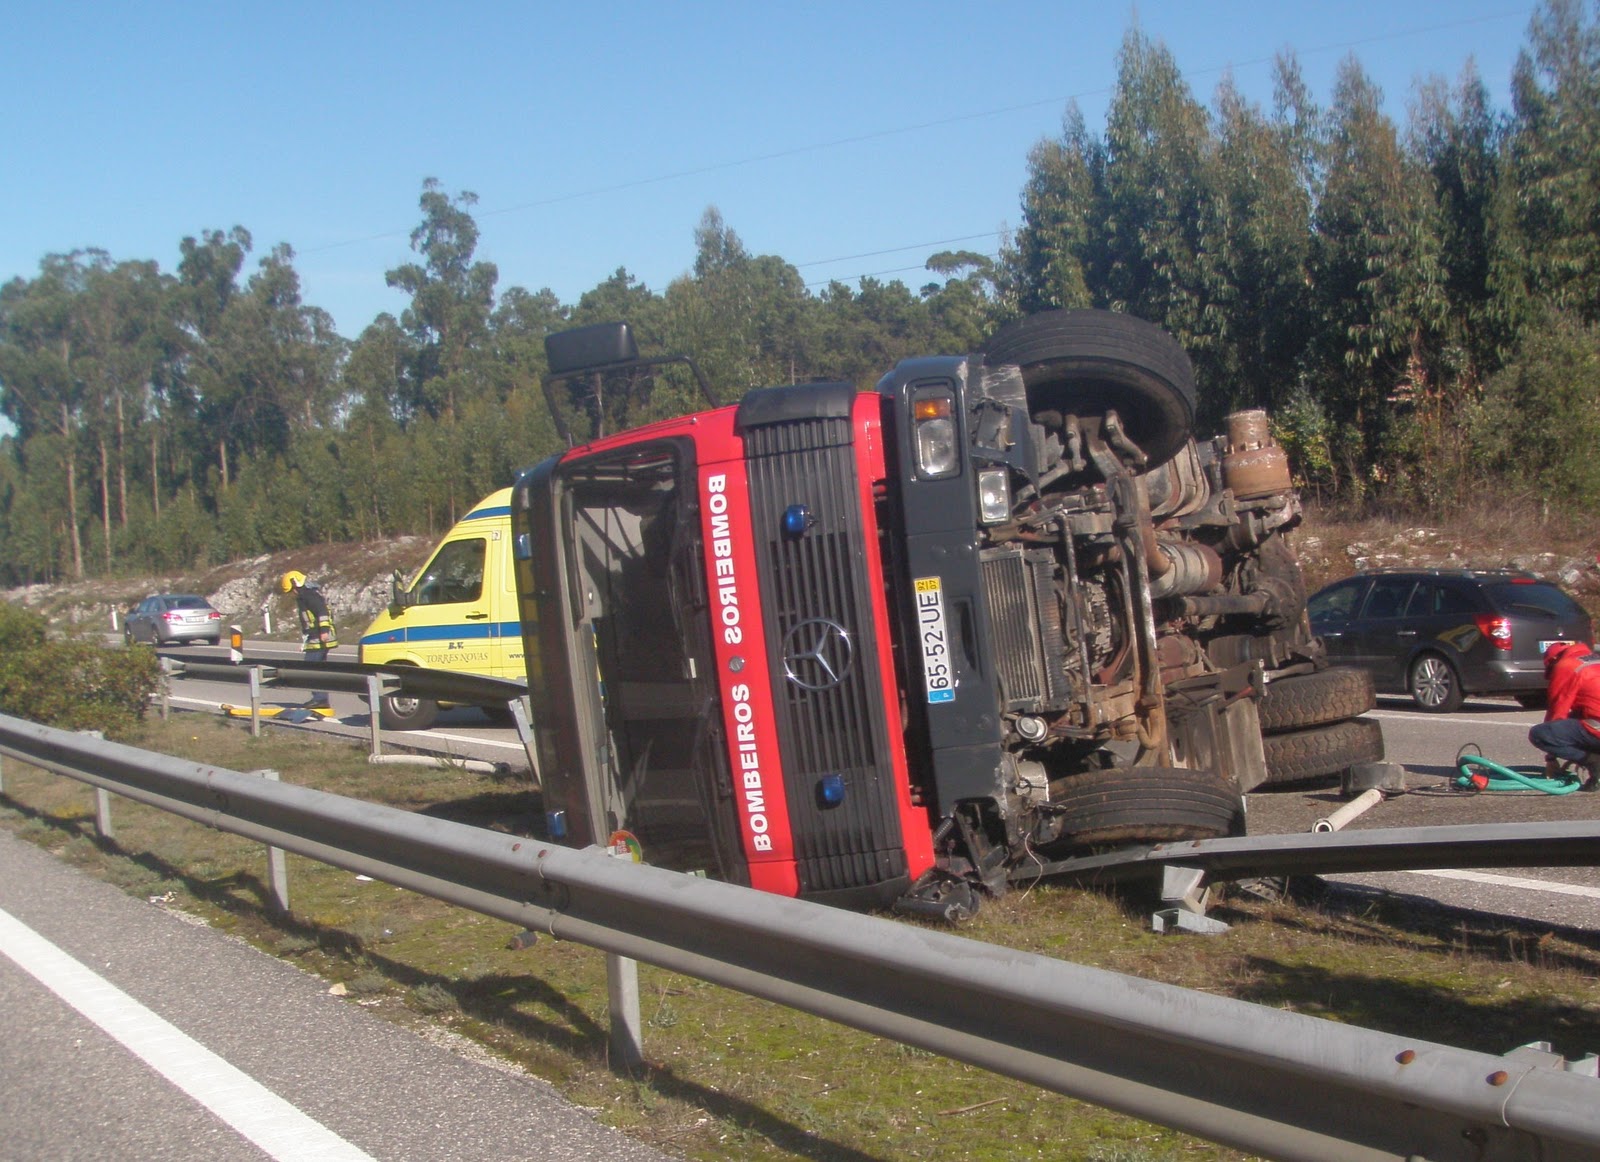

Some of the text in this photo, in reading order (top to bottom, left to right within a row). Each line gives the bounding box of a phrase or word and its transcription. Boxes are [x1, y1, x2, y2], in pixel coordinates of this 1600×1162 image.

[427, 652, 488, 664] TORRES NOVAS
[732, 684, 773, 851] BOMBEIROS
